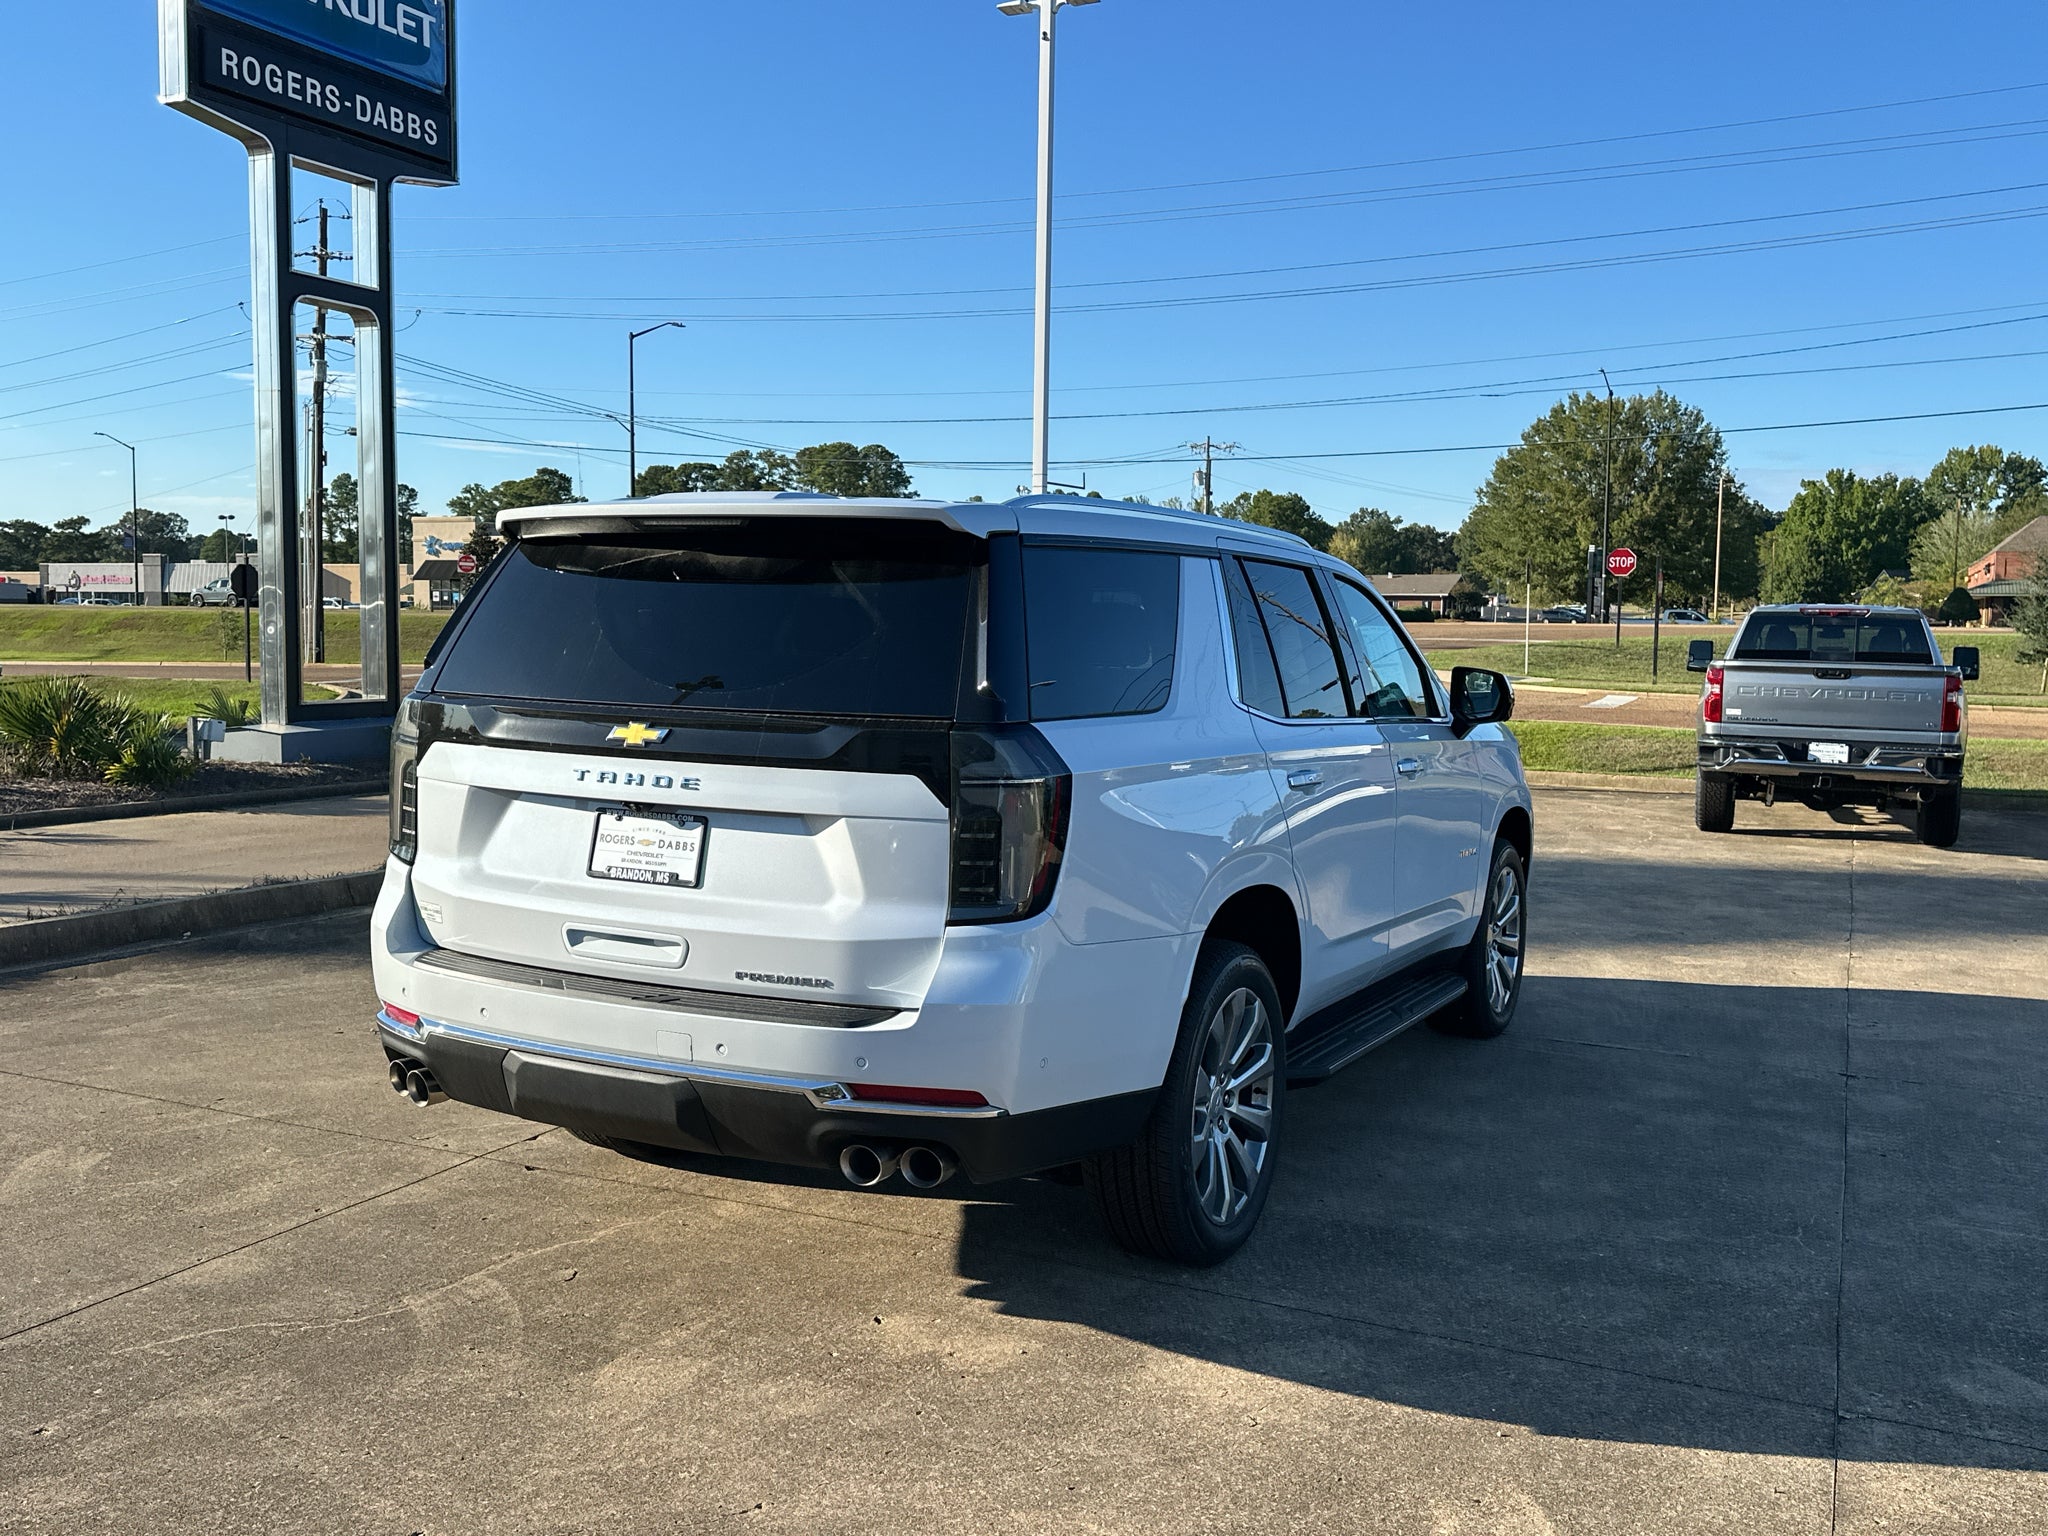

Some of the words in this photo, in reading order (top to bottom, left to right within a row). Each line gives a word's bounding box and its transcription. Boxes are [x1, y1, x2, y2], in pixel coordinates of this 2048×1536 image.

[221, 47, 438, 146] ROGERS-DABBS
[1608, 556, 1634, 568] STOP
[1737, 685, 1931, 702] CHEVROLET
[573, 768, 702, 791] TAHOE
[599, 833, 636, 846] ROGERS
[657, 839, 695, 852] DABBS
[626, 850, 665, 859] CHEVROLET
[610, 866, 654, 884] BRANDON,
[656, 871, 670, 884] MS
[735, 971, 835, 990] PREMIER
